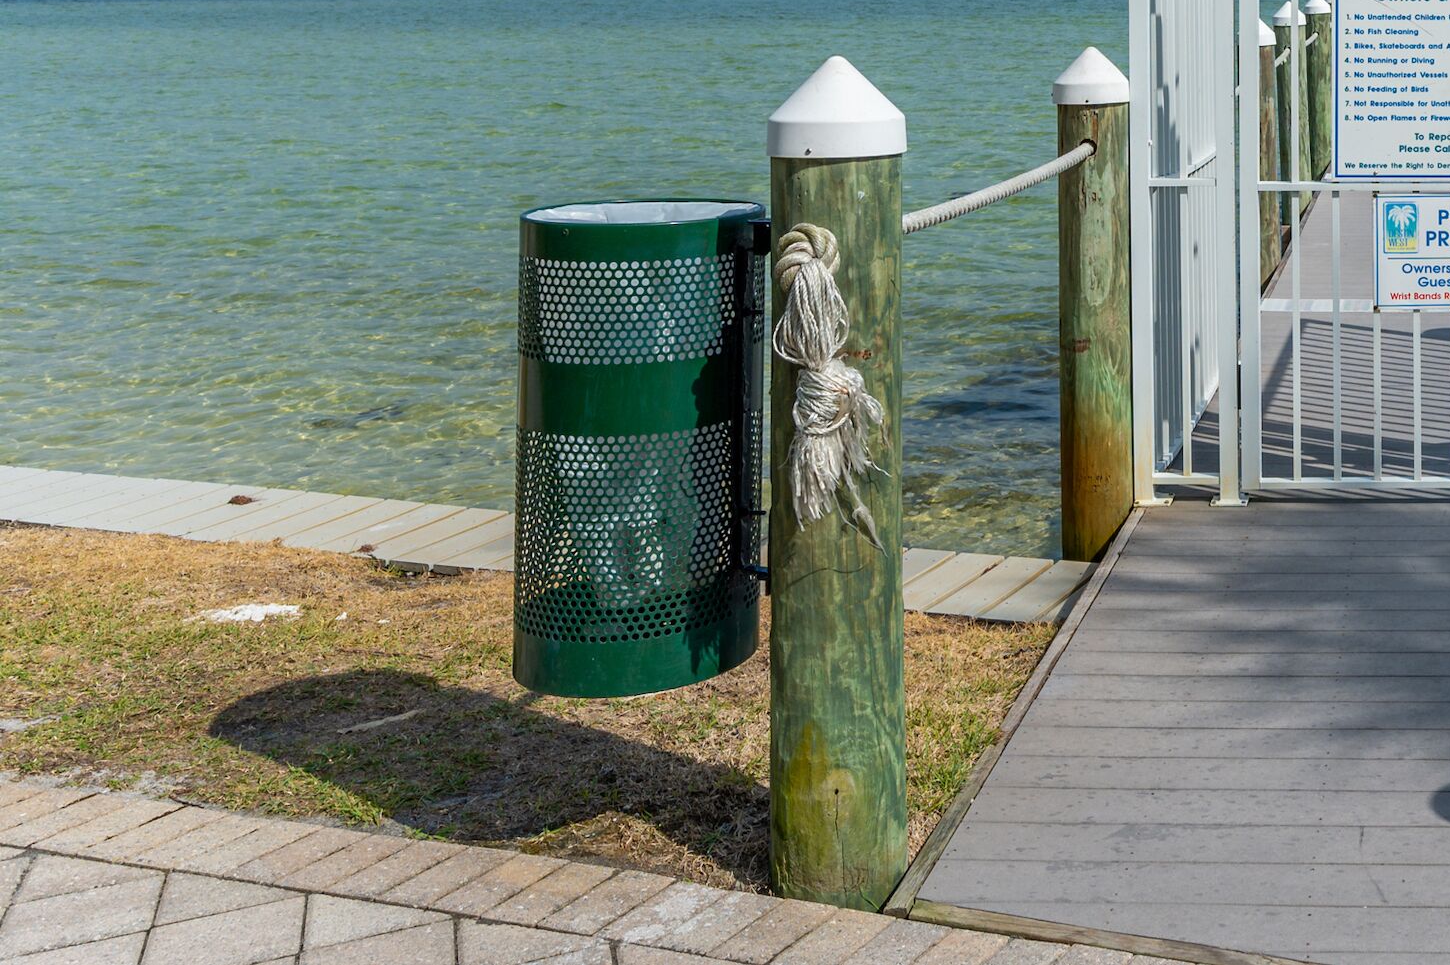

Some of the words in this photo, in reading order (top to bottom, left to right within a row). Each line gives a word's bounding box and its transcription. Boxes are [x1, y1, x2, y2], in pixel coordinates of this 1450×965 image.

[1385, 28, 1419, 36] Cleaning
[1368, 57, 1398, 65] Running
[1411, 57, 1435, 65] Diving
[1367, 86, 1397, 94] Feeding
[1370, 100, 1414, 108] Responsible
[1399, 145, 1430, 153] Please
